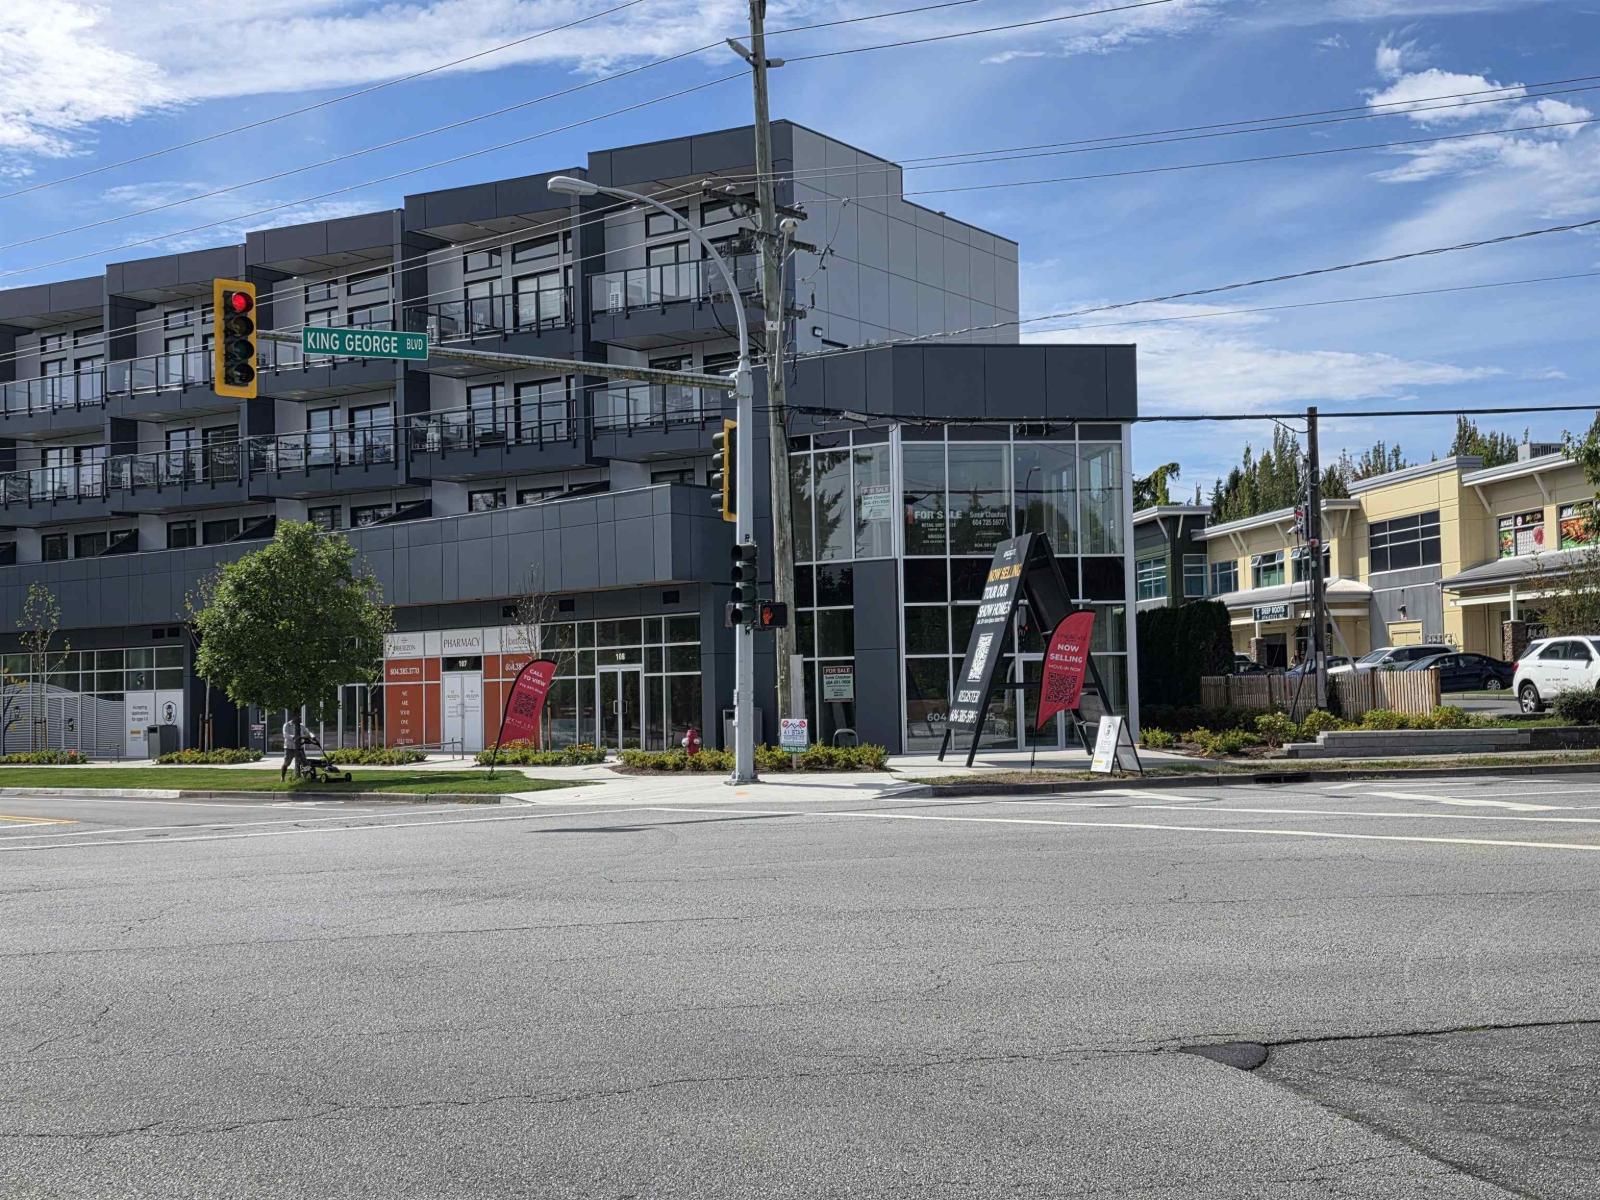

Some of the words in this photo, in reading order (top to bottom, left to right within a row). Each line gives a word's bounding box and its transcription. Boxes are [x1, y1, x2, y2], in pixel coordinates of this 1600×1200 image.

[307, 332, 340, 350] KING
[345, 334, 398, 353] GEORGE
[406, 338, 423, 350] BLVD
[914, 510, 934, 519] FOR
[936, 510, 962, 519] SLE
[984, 585, 997, 599] TOUR
[997, 583, 1008, 598] OUR
[977, 604, 992, 617] SHOW
[443, 637, 480, 648] PHARMACY
[1058, 643, 1079, 652] NOW
[1050, 653, 1082, 663] SELLING
[529, 669, 543, 678] CALL
[532, 678, 546, 687] VIEW
[927, 713, 946, 721] 604
